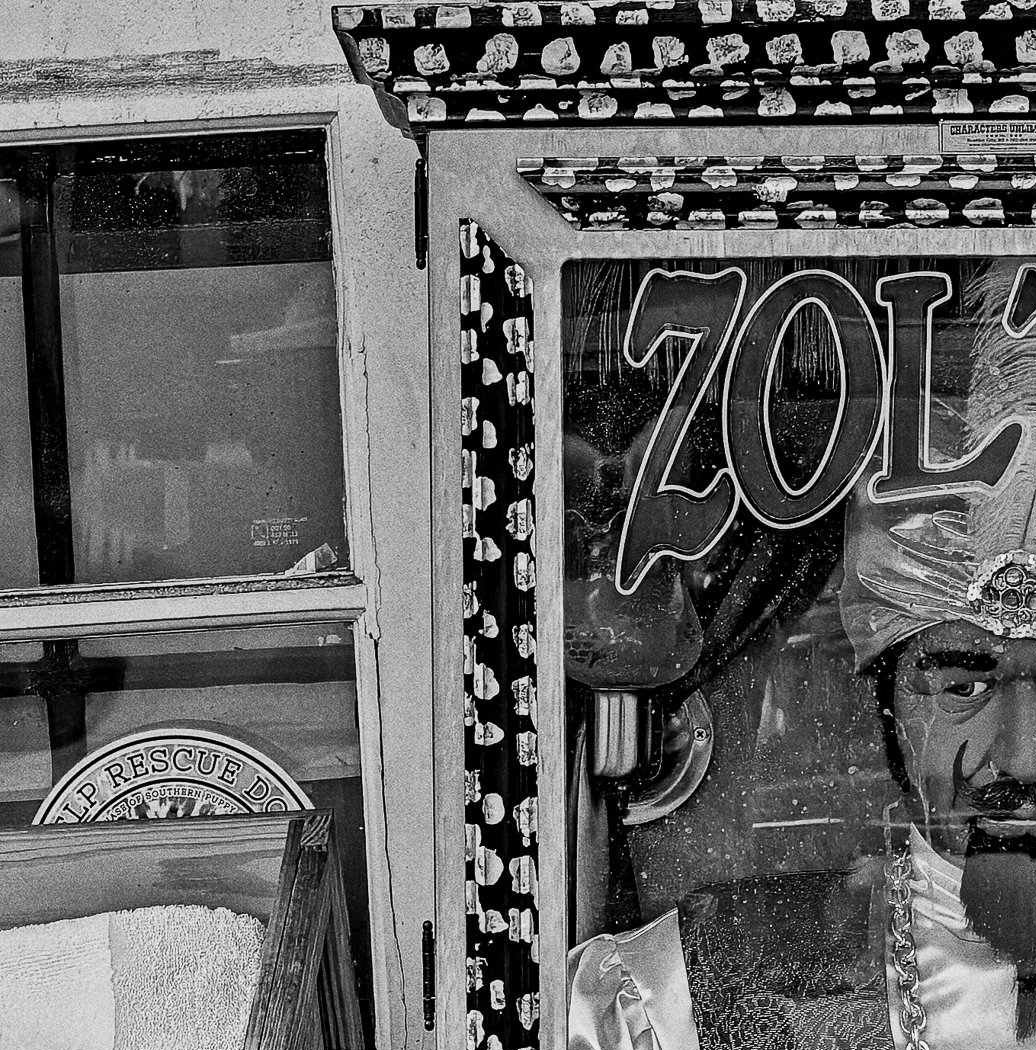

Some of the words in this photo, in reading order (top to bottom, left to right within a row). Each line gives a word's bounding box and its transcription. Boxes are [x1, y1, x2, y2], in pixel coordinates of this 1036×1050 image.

[950, 124, 1008, 135] CHARACTERS
[104, 748, 243, 789] RESCUE
[129, 795, 143, 807] OF
[145, 787, 202, 800] SOUTHERN
[204, 793, 237, 813] PUPPY
